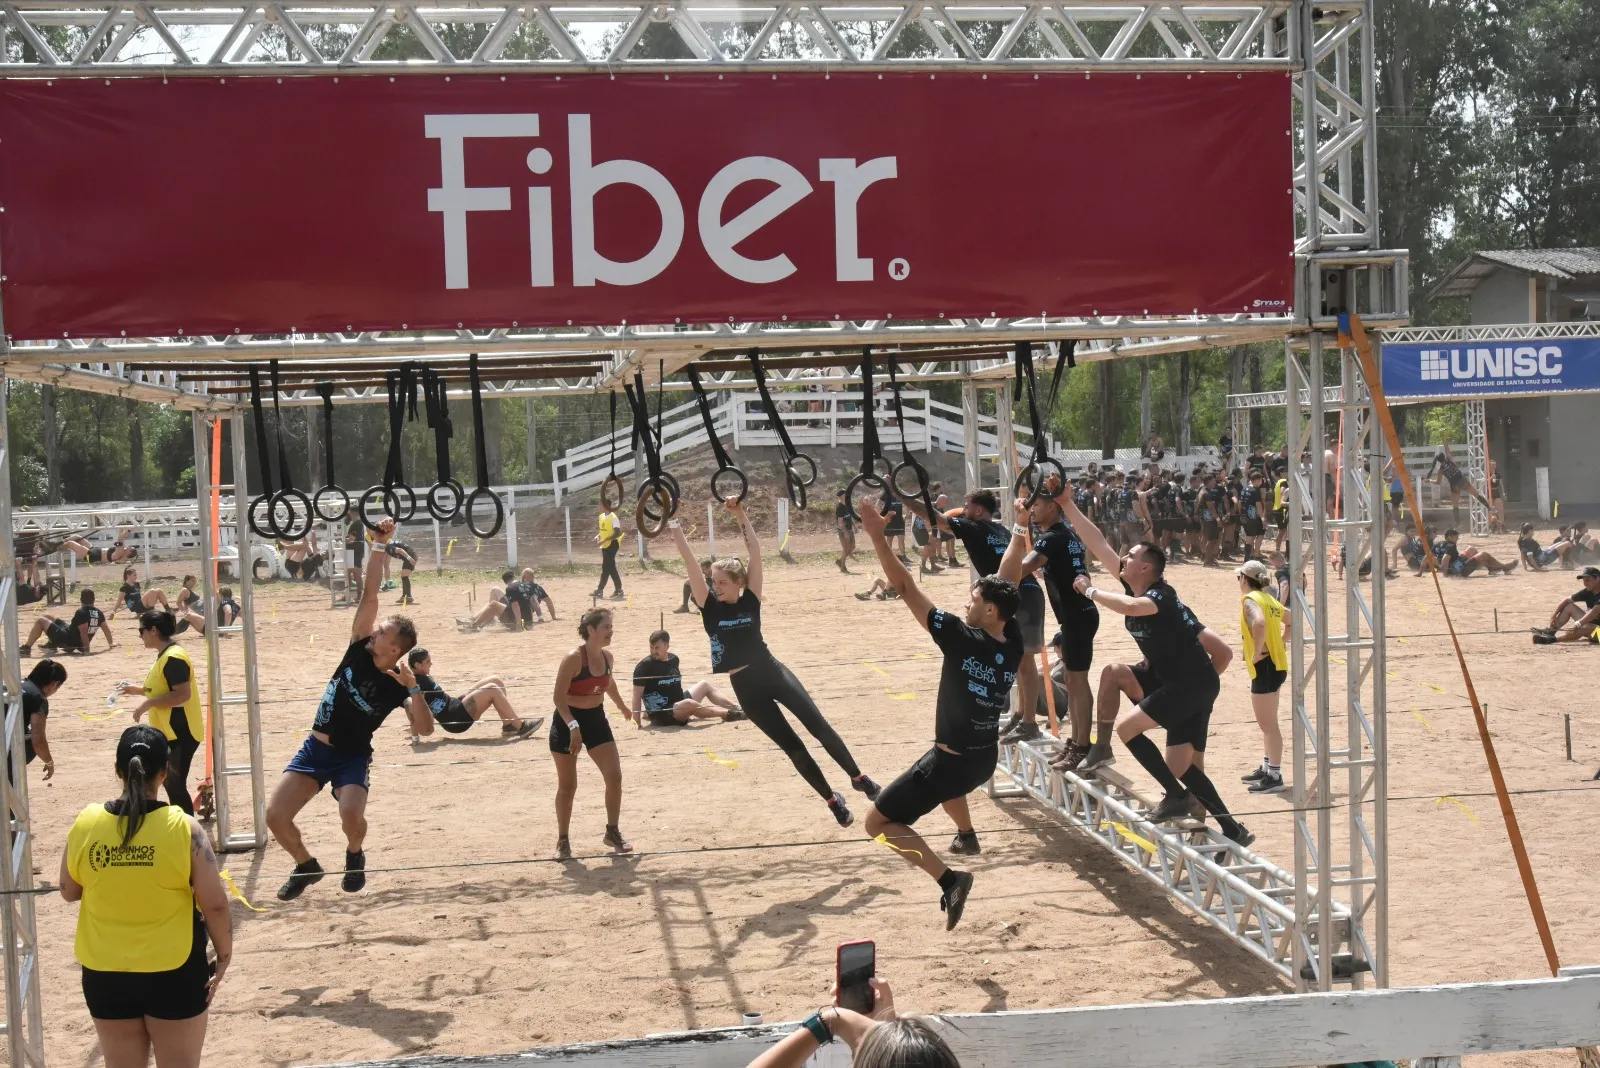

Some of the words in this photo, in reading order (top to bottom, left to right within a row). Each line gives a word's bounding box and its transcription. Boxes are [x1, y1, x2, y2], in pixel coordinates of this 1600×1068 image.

[1451, 346, 1562, 379] UNISC
[1452, 380, 1495, 388] UNIVERSIDADE
[110, 845, 155, 855] MOINHOS
[125, 853, 154, 861] CAMPO
